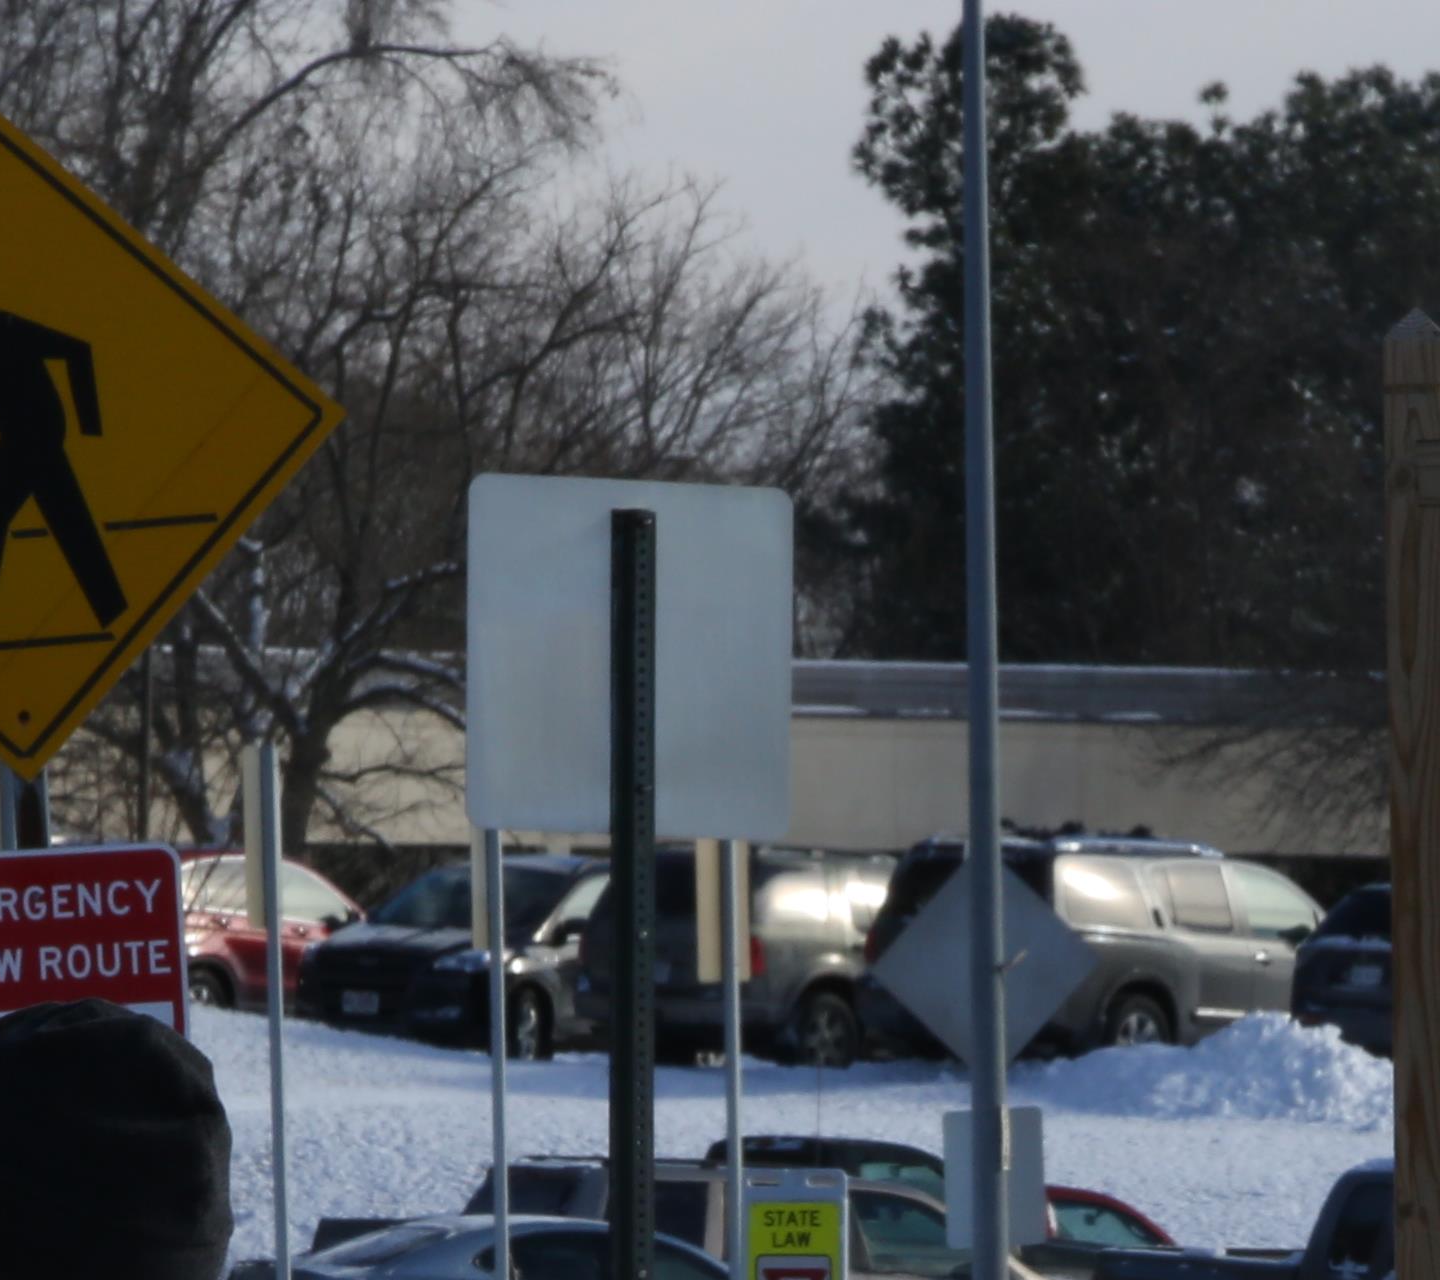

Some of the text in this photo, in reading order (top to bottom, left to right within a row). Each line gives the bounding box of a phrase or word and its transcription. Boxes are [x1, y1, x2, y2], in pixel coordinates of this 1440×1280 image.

[39, 939, 172, 981] ROUTE
[763, 1209, 821, 1228] STATE
[771, 1231, 812, 1249] LAW
